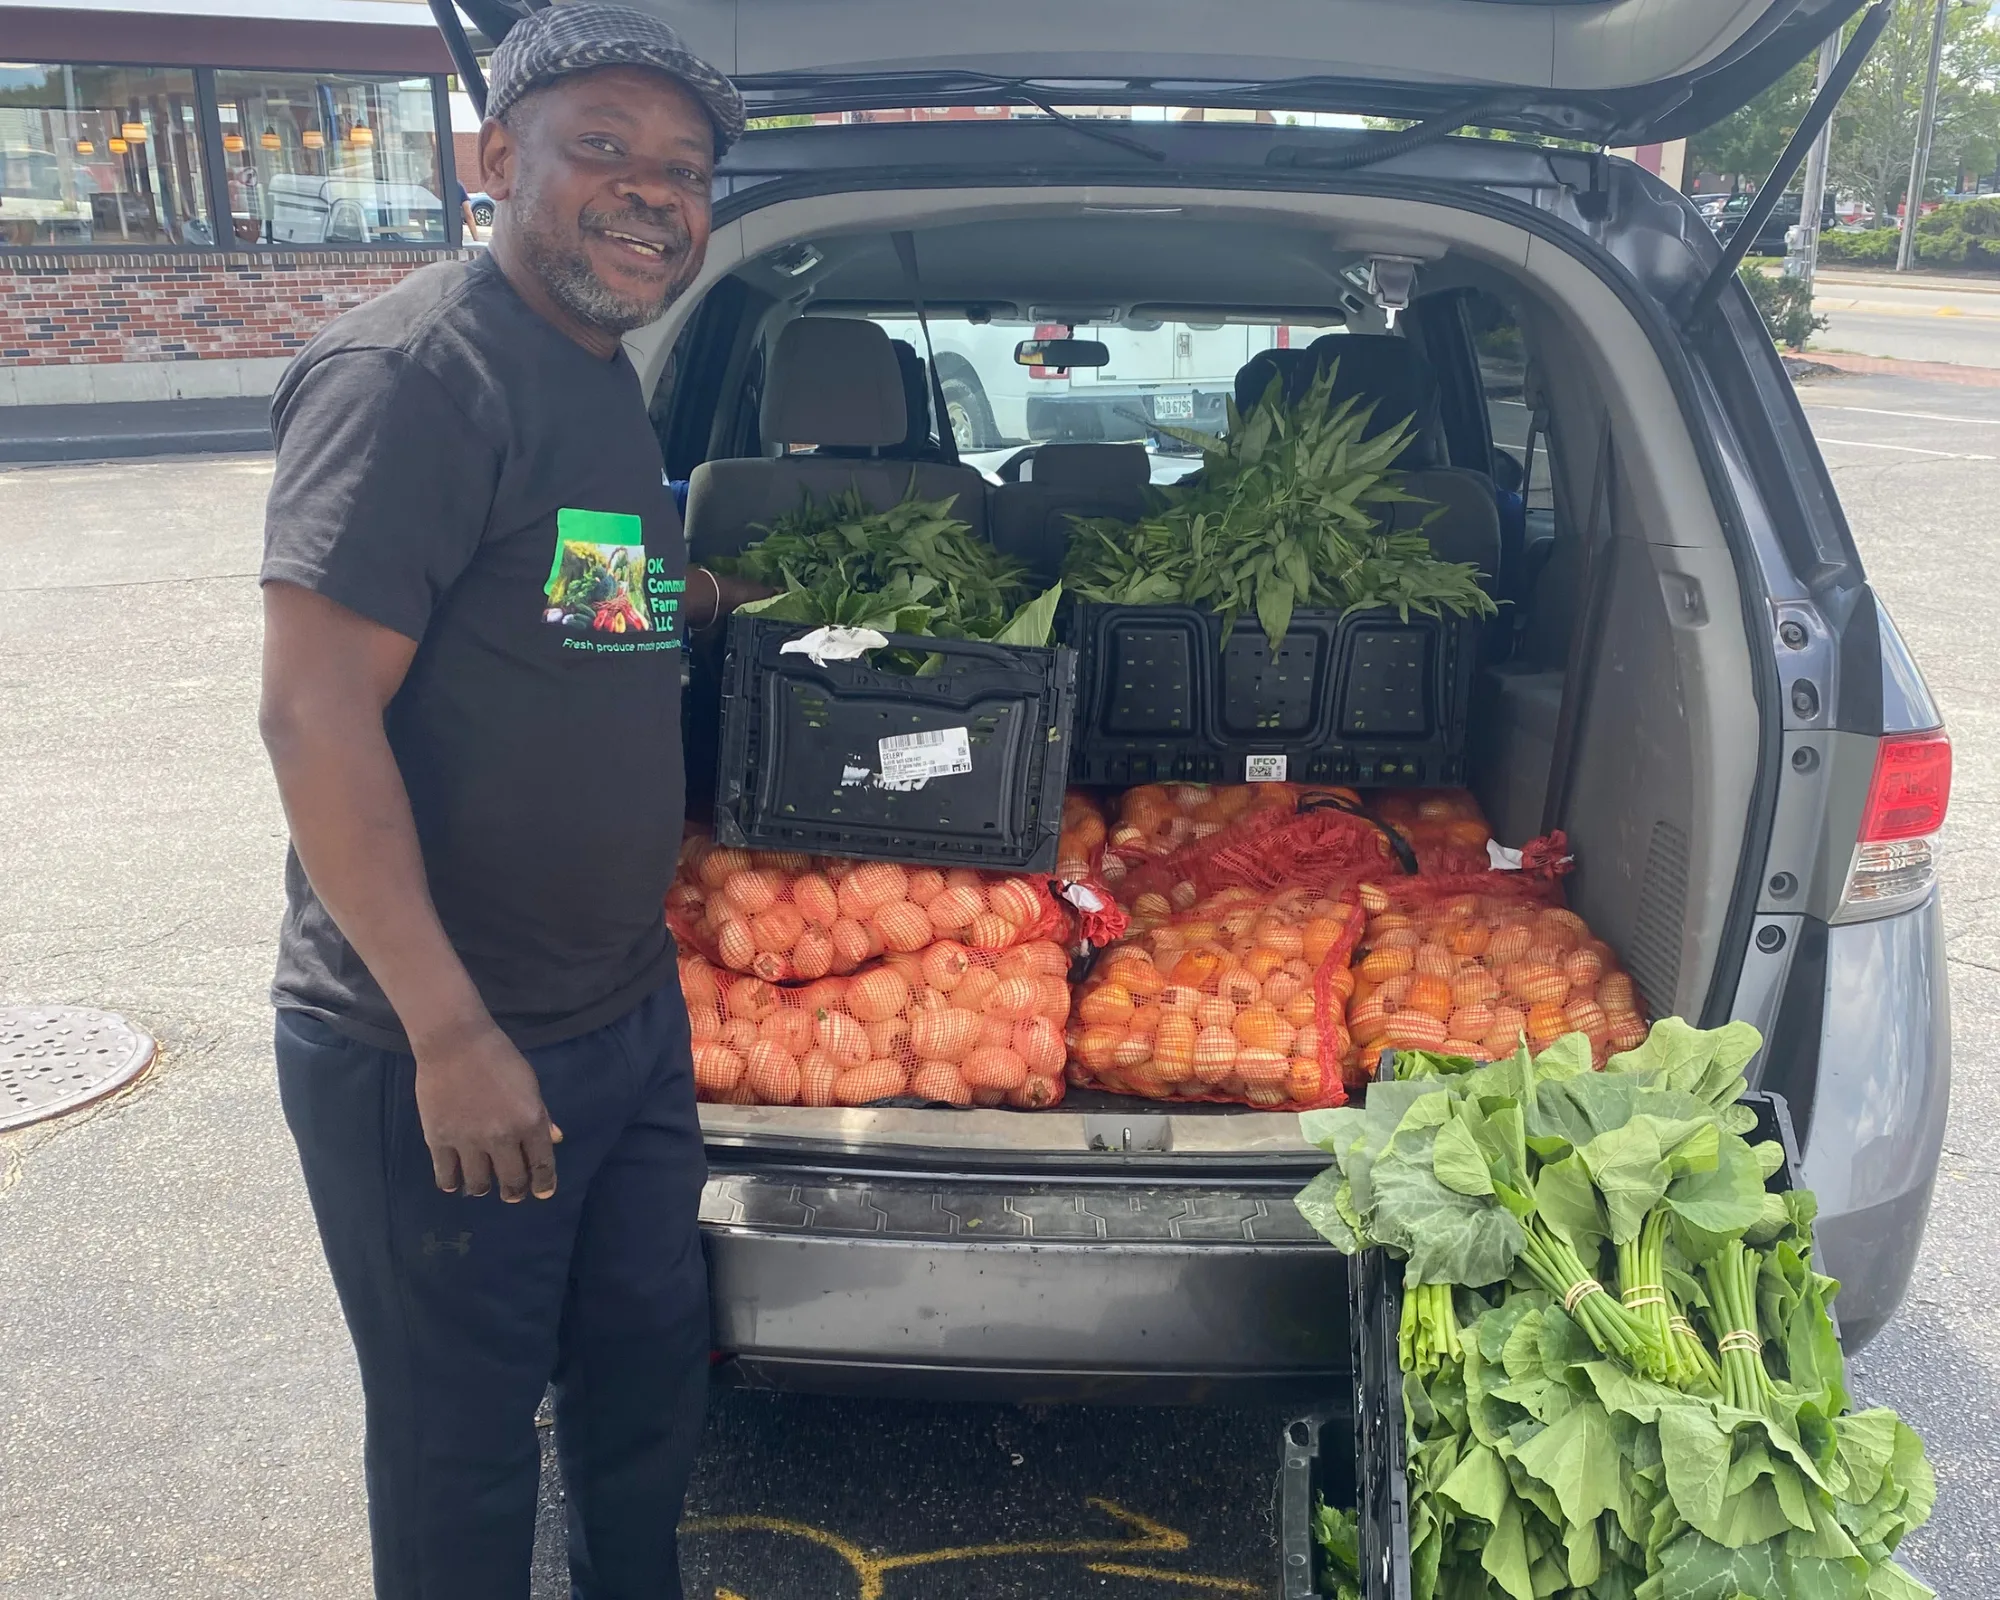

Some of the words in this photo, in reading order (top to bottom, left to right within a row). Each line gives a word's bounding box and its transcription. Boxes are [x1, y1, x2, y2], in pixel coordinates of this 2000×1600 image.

[647, 558, 665, 574] OK
[650, 597, 678, 613] Farm
[654, 615, 674, 632] LLC
[562, 638, 594, 650] Fresh
[597, 640, 635, 653] produce
[882, 752, 904, 760] CELERY
[1253, 757, 1277, 765] IFCO
